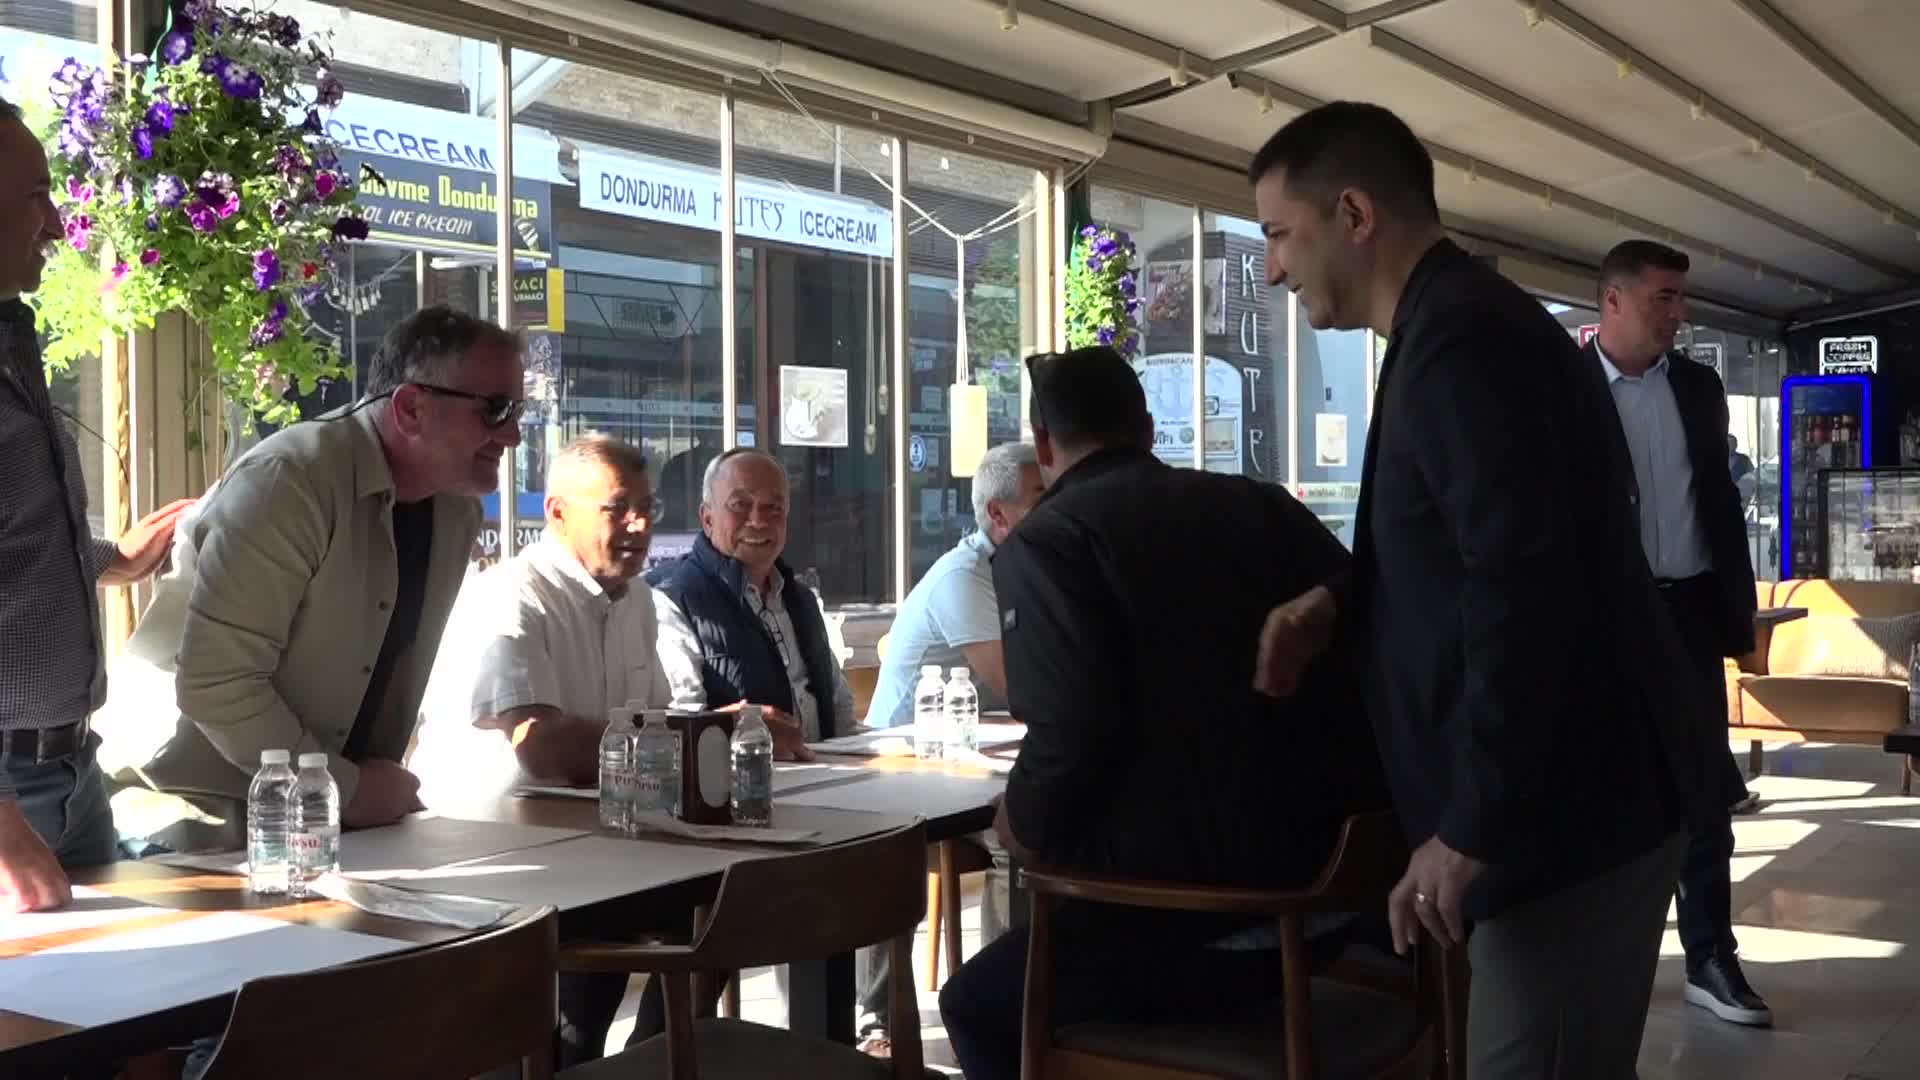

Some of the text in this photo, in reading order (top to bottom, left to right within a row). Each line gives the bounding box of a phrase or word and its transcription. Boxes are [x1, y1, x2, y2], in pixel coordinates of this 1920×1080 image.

[324, 119, 496, 170] CECREAM
[438, 175, 538, 219] Donduma
[601, 173, 697, 216] DONDURMA
[799, 209, 878, 244] ICECREAM
[388, 208, 415, 226] ICE
[416, 213, 473, 235] CREAM
